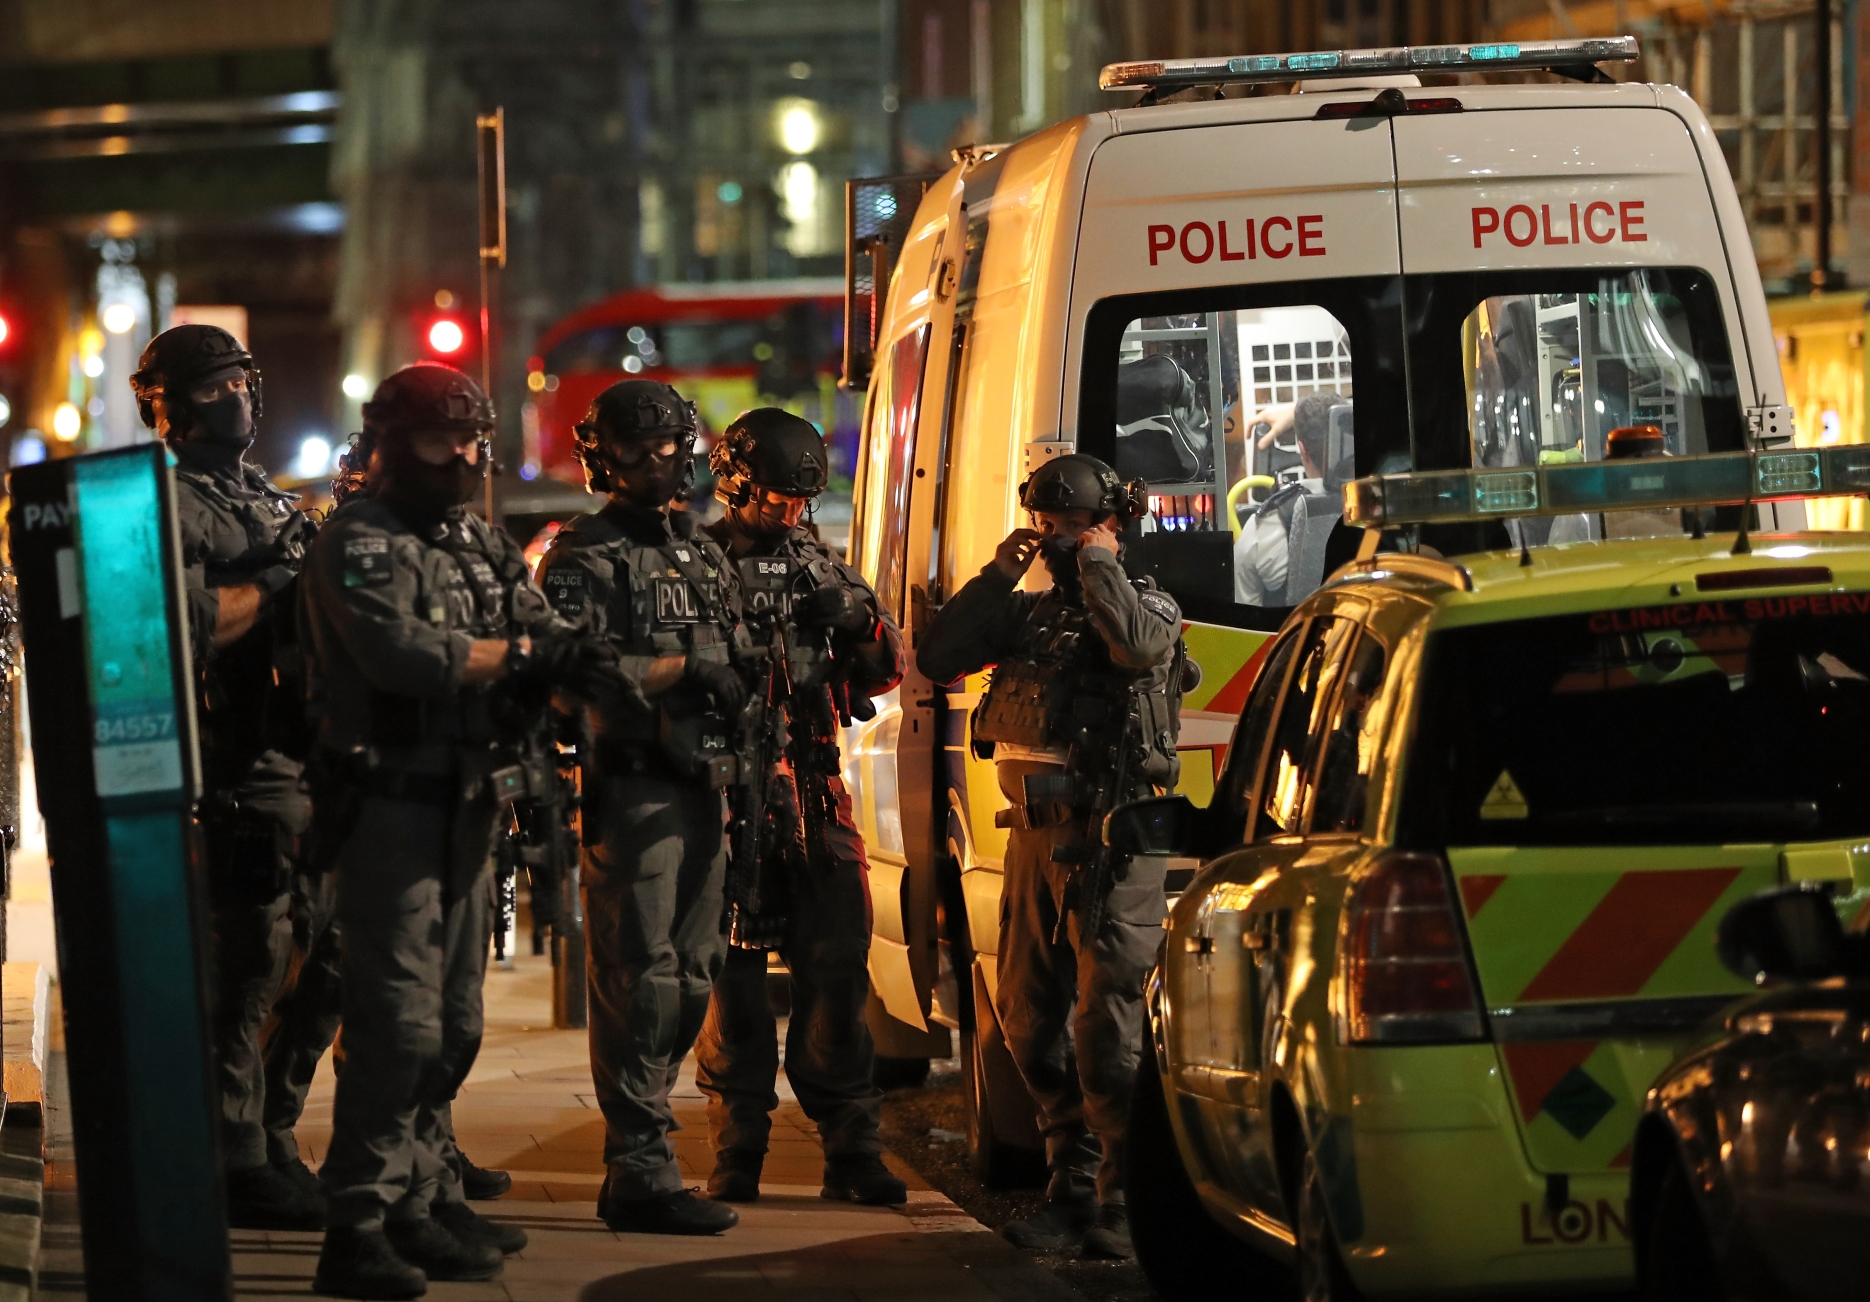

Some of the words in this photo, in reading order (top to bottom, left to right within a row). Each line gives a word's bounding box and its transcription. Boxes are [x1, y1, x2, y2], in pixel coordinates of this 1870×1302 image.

[1147, 214, 1326, 266] POLICE
[1471, 200, 1648, 248] POLICE
[23, 501, 71, 532] PAY
[547, 575, 583, 586] POLICE
[558, 588, 568, 599] 9
[660, 582, 718, 617] POLE
[1588, 602, 1735, 633] CLINICAL
[1744, 594, 1870, 620] SUPERV
[1520, 1198, 1633, 1245] LON
